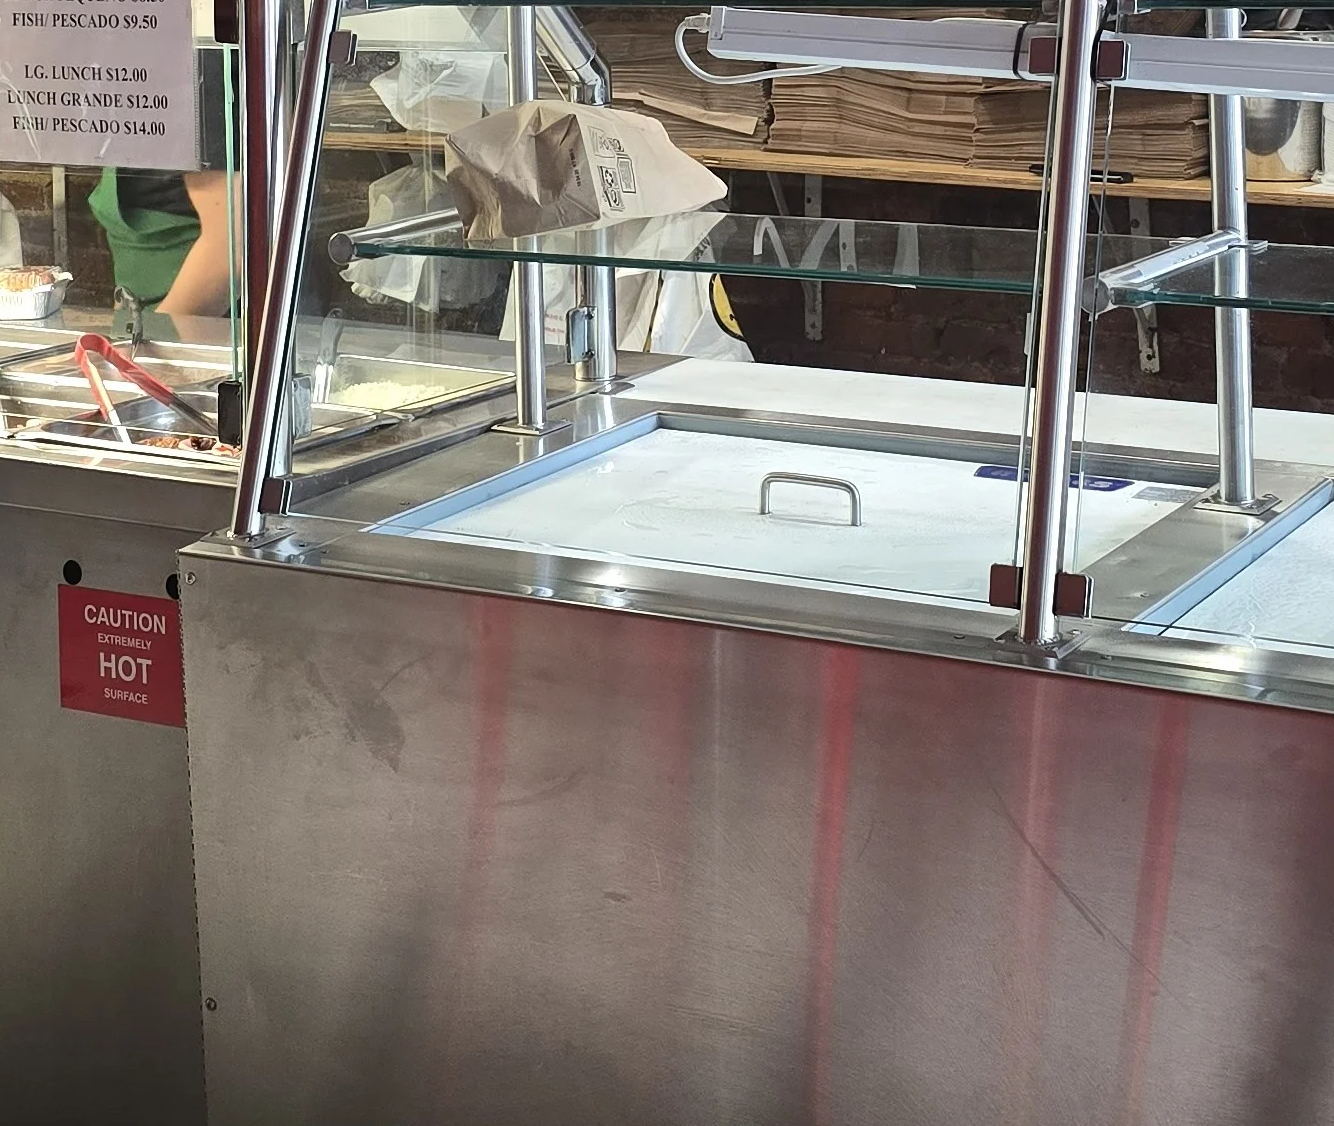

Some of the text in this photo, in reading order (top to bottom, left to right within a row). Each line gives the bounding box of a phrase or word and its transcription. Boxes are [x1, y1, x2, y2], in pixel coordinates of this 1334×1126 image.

[12, 12, 158, 30] FISH/ PESCADO $9.50
[24, 64, 148, 83] LG. LUNCH $12.00
[7, 89, 169, 110] LUNCH GRANDE $12.00
[52, 117, 120, 134] PESCADO
[123, 120, 166, 136] $14.00
[84, 604, 166, 635] CAUTION
[97, 633, 152, 650] EXTREMELY
[99, 652, 152, 684] HOT
[104, 687, 148, 705] SURFACE
